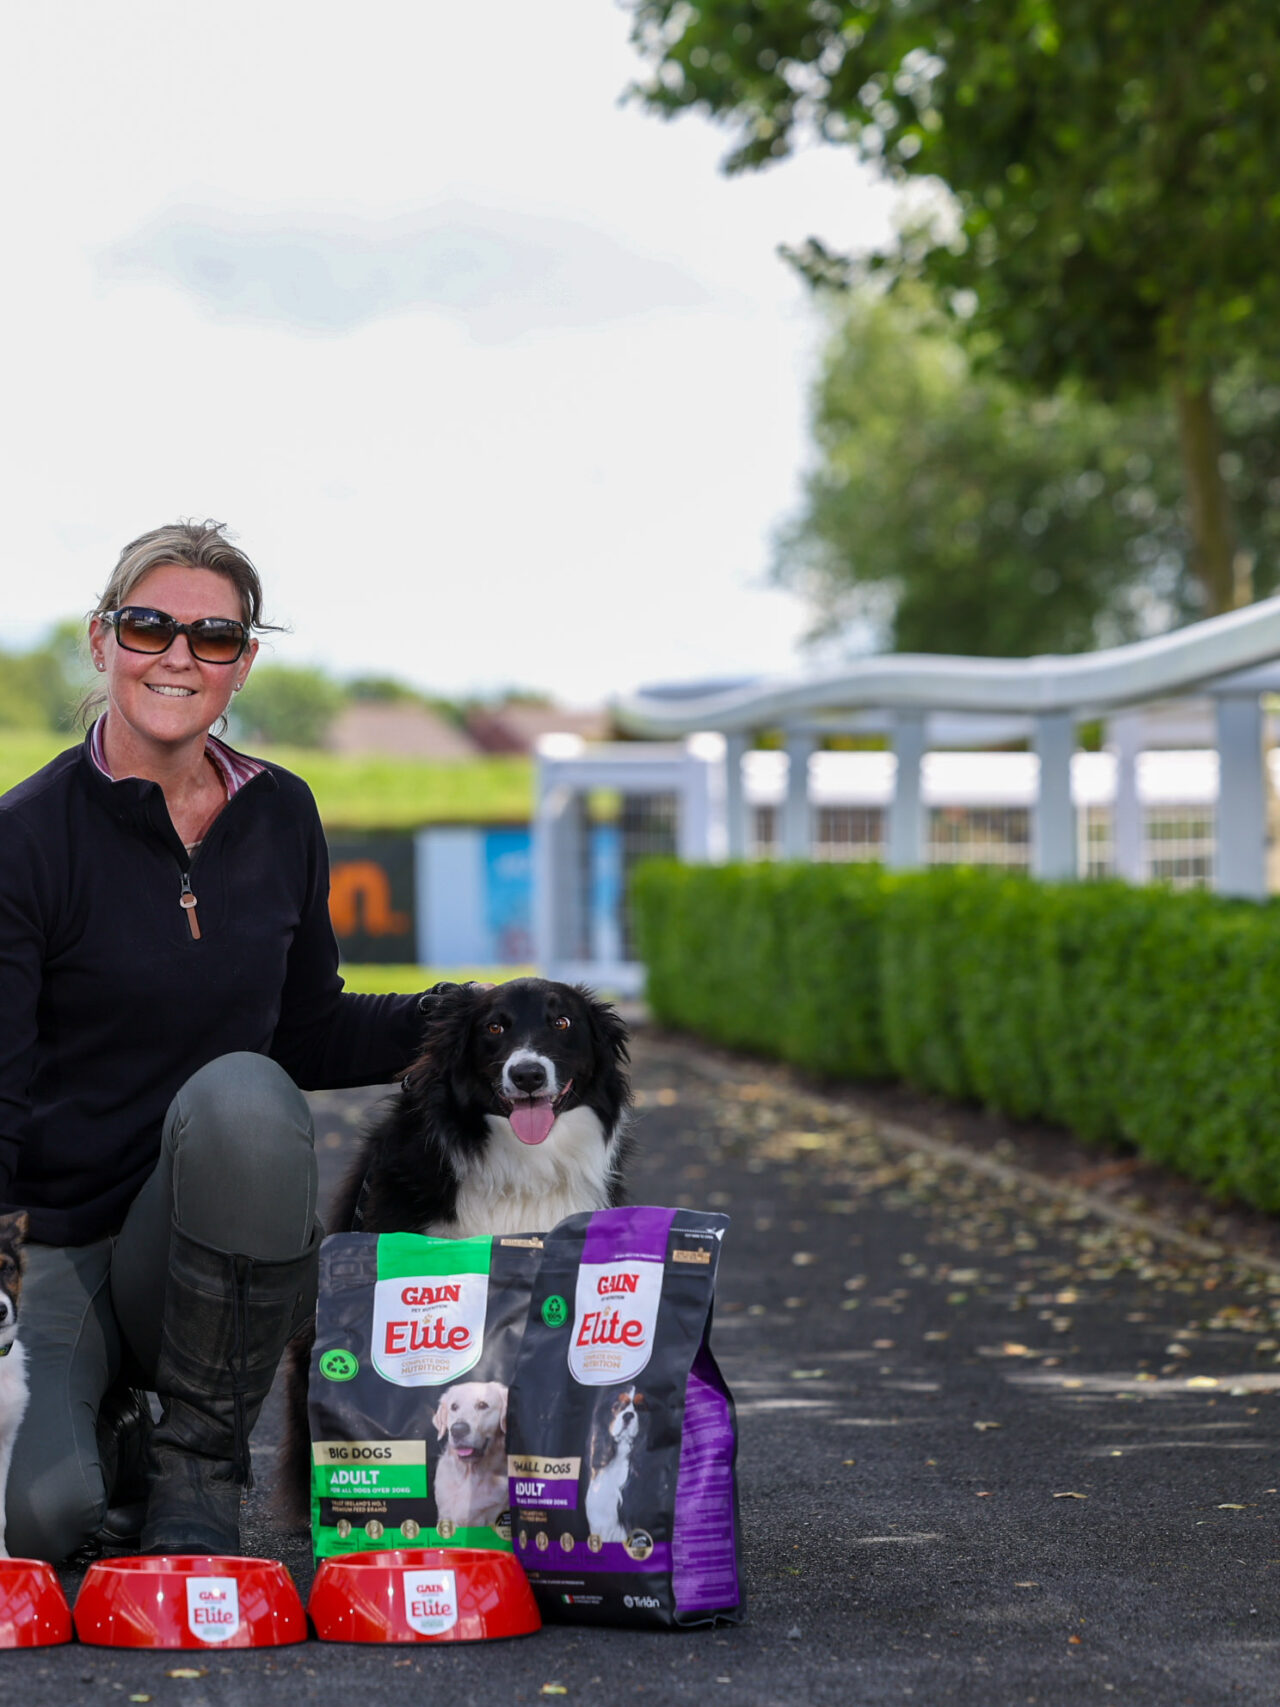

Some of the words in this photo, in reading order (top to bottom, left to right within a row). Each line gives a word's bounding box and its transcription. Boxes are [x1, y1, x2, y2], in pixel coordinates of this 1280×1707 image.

[401, 1284, 461, 1306] GAIN
[384, 1317, 473, 1355] Elite
[576, 1310, 646, 1348] Elite
[401, 1364, 450, 1375] NUTRITION
[328, 1447, 349, 1459] BIG
[352, 1447, 392, 1459] DOGS
[543, 1463, 572, 1474] DOGS
[330, 1470, 380, 1485] ADULT
[194, 1608, 235, 1625] Elite
[411, 1600, 453, 1617] Elite
